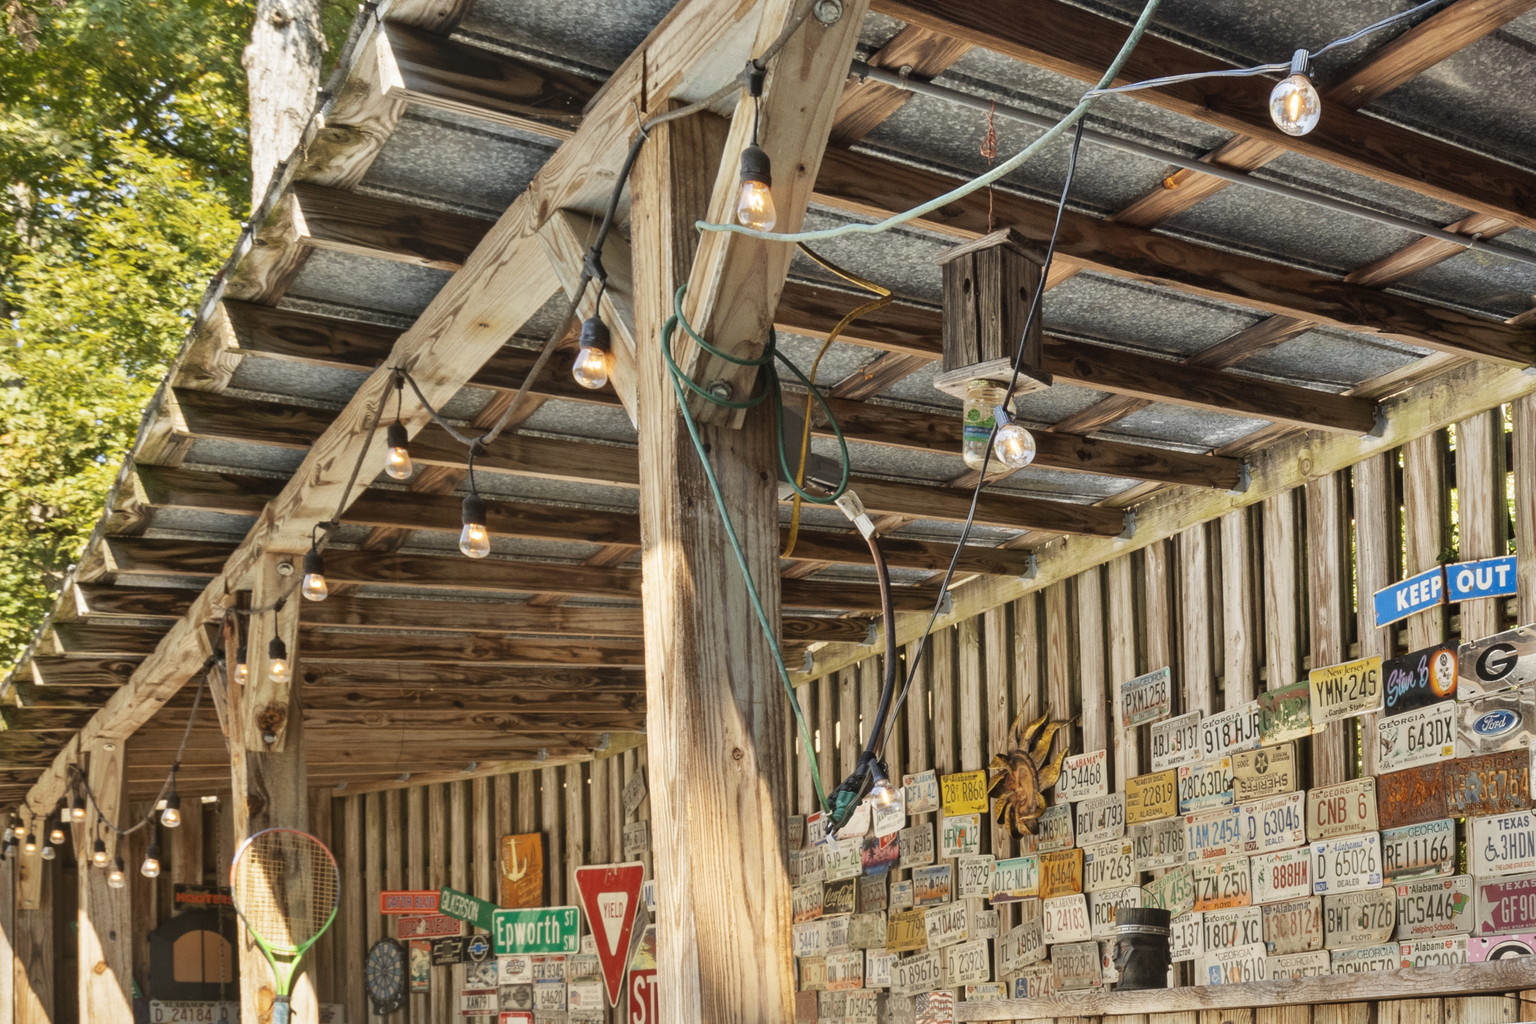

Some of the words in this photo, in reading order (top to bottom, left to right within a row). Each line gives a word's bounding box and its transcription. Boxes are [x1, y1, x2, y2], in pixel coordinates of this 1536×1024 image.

[1396, 574, 1442, 612] KEEP
[1457, 564, 1511, 593] OUT
[1327, 667, 1342, 678] New
[1344, 663, 1364, 675] Jersey
[1476, 643, 1519, 682] G
[1140, 671, 1167, 687] GEORGIA
[1125, 681, 1167, 715] PXM1258
[1329, 707, 1347, 717] Garden
[1202, 712, 1241, 730] GEORGIA
[1378, 713, 1426, 731] GEORGIA
[1481, 712, 1507, 732] Ford
[1153, 732, 1170, 759] ABJ
[1176, 724, 1198, 752] 9137
[1204, 724, 1231, 754] 918
[1407, 716, 1453, 752] 643DX
[1071, 763, 1102, 790] 54468
[1143, 782, 1173, 808] 22819
[1323, 785, 1359, 798] GEORGIA
[1139, 807, 1164, 818] ALABAMA
[1258, 798, 1288, 813] Alabama
[1317, 797, 1347, 827] CNB
[1357, 793, 1367, 820] 6
[1247, 816, 1256, 840] D
[1263, 805, 1300, 837] 63046
[1344, 823, 1361, 831] STATE
[1407, 823, 1450, 838] GEORGIA
[1497, 815, 1530, 831] TEXAS
[1212, 817, 1241, 846] 2454
[1265, 836, 1285, 846] DEALER
[1330, 840, 1364, 854] Alabama
[1097, 845, 1118, 857] TEXAS
[1202, 847, 1227, 859] Alabama
[1110, 855, 1131, 881] 263
[1317, 854, 1326, 879] D
[1335, 847, 1376, 877] 65026
[1154, 870, 1182, 891] GEORGIA
[1223, 871, 1248, 899] 250
[1337, 878, 1360, 888] DEALER
[1410, 882, 1444, 894] Alabama
[386, 896, 412, 909] GATOR
[414, 896, 436, 909] BLVD
[441, 890, 480, 922] GILKERSON
[1214, 901, 1231, 909] FLOYD
[1342, 892, 1380, 906] GEORGIA
[603, 902, 624, 918] YIELD
[1275, 902, 1309, 914] Alabama
[1362, 902, 1392, 930] 6726
[425, 917, 459, 934] AVENUE
[564, 910, 575, 926] ST
[1046, 911, 1052, 933] D
[1057, 907, 1085, 932] 24183
[1204, 913, 1240, 924] GEORGIA
[496, 914, 560, 952] Epworth
[1206, 922, 1237, 950] 1807
[1242, 919, 1259, 946] XC
[1412, 925, 1434, 934] Helping
[1434, 923, 1455, 931] Schools
[563, 935, 575, 951] SW
[1413, 941, 1445, 952] Alabama
[901, 953, 931, 967] Alabama
[1217, 948, 1252, 962] GEORGIA
[1280, 956, 1315, 967] GEORGIA
[1356, 947, 1395, 960] GEORGIA
[909, 959, 940, 984] 89676
[155, 1008, 163, 1022] D
[172, 1008, 212, 1022] 24184
